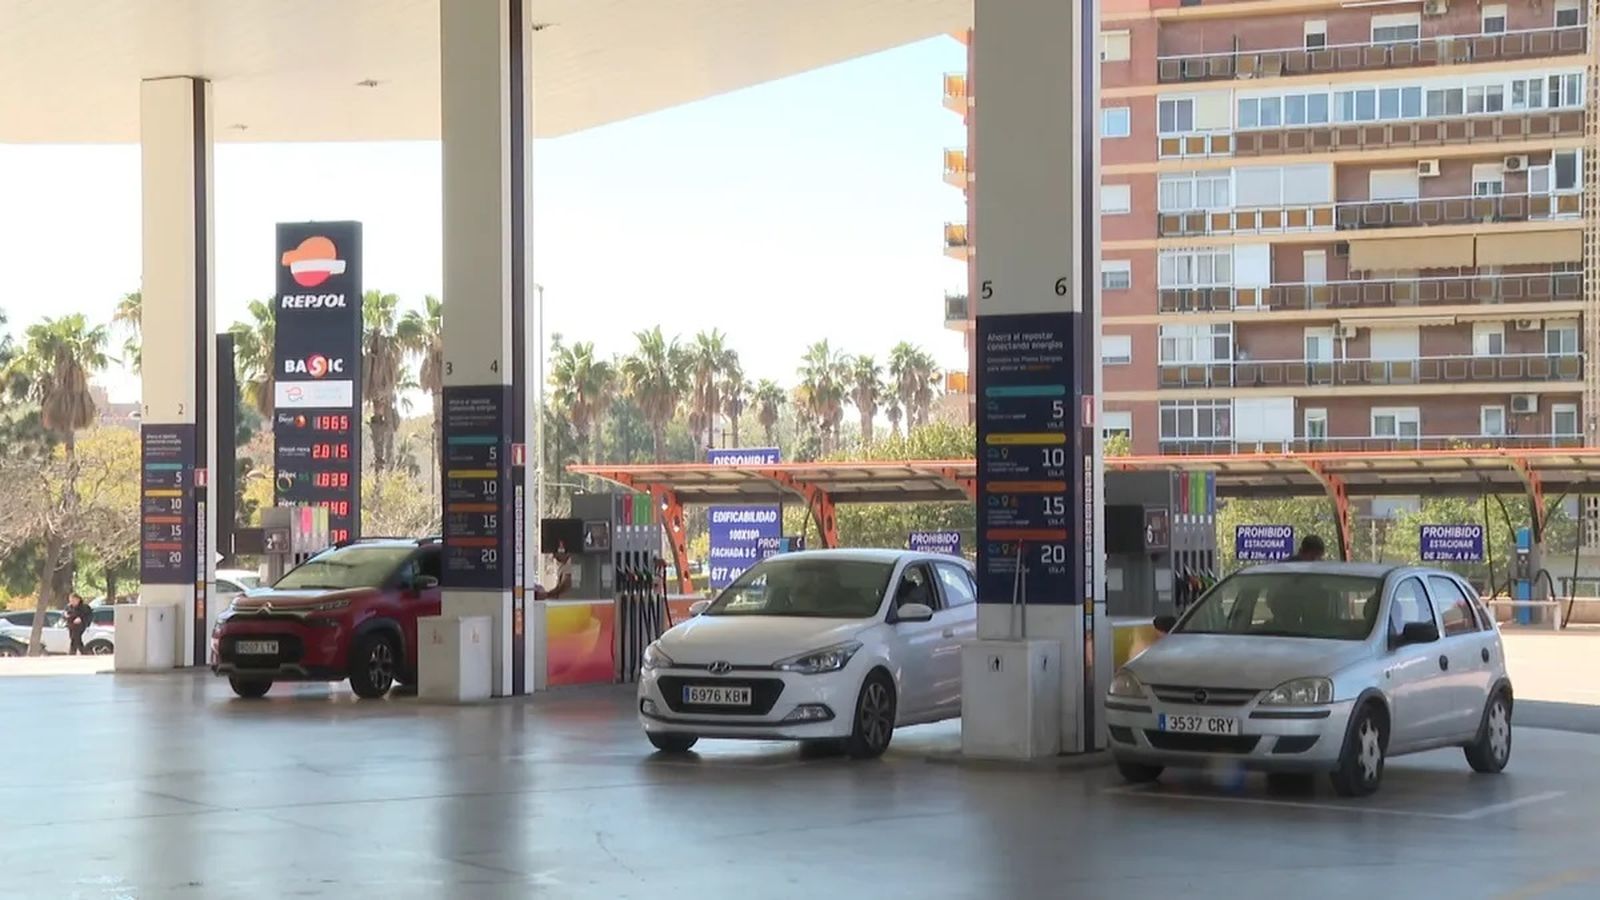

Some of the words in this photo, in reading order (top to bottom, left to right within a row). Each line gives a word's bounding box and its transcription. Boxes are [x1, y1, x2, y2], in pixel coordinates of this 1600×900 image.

[982, 280, 993, 299] 5
[1055, 277, 1067, 296] 6
[281, 294, 346, 308] REPSOL
[285, 354, 343, 378] BASIC
[446, 362, 453, 375] 3
[490, 360, 498, 374] 4
[145, 405, 149, 416] 1
[178, 404, 184, 415] 2
[1053, 400, 1064, 418] 5
[489, 446, 497, 460] 5
[713, 455, 775, 464] DISPONIBLE
[1041, 449, 1065, 467] 10
[175, 472, 182, 483] 5
[483, 480, 497, 494] 10
[171, 498, 182, 510] 10
[1043, 497, 1065, 515] 15
[483, 514, 497, 528] 15
[713, 511, 777, 523] EDIFICABILIDAD
[171, 525, 182, 536] 15
[1147, 525, 1153, 543] 6
[1238, 527, 1291, 538] PROHIBIDO
[1423, 527, 1480, 538] PROHIBIDO
[267, 538, 273, 549] 2
[586, 532, 592, 545] 4
[911, 534, 959, 544] PROHIBIDO
[1244, 539, 1285, 548] ESTACIONAR
[1429, 540, 1473, 548] ESTACIONAR
[169, 551, 182, 563] 20
[481, 549, 497, 563] 20
[711, 547, 744, 558] FACHADA
[1041, 545, 1065, 563] 20
[1238, 551, 1249, 559] DE
[1268, 551, 1274, 559] A
[711, 567, 727, 580] 677
[691, 689, 721, 702] 6976
[725, 690, 748, 703] KBW
[1170, 716, 1202, 731] 3537
[1208, 718, 1233, 732] CRY
